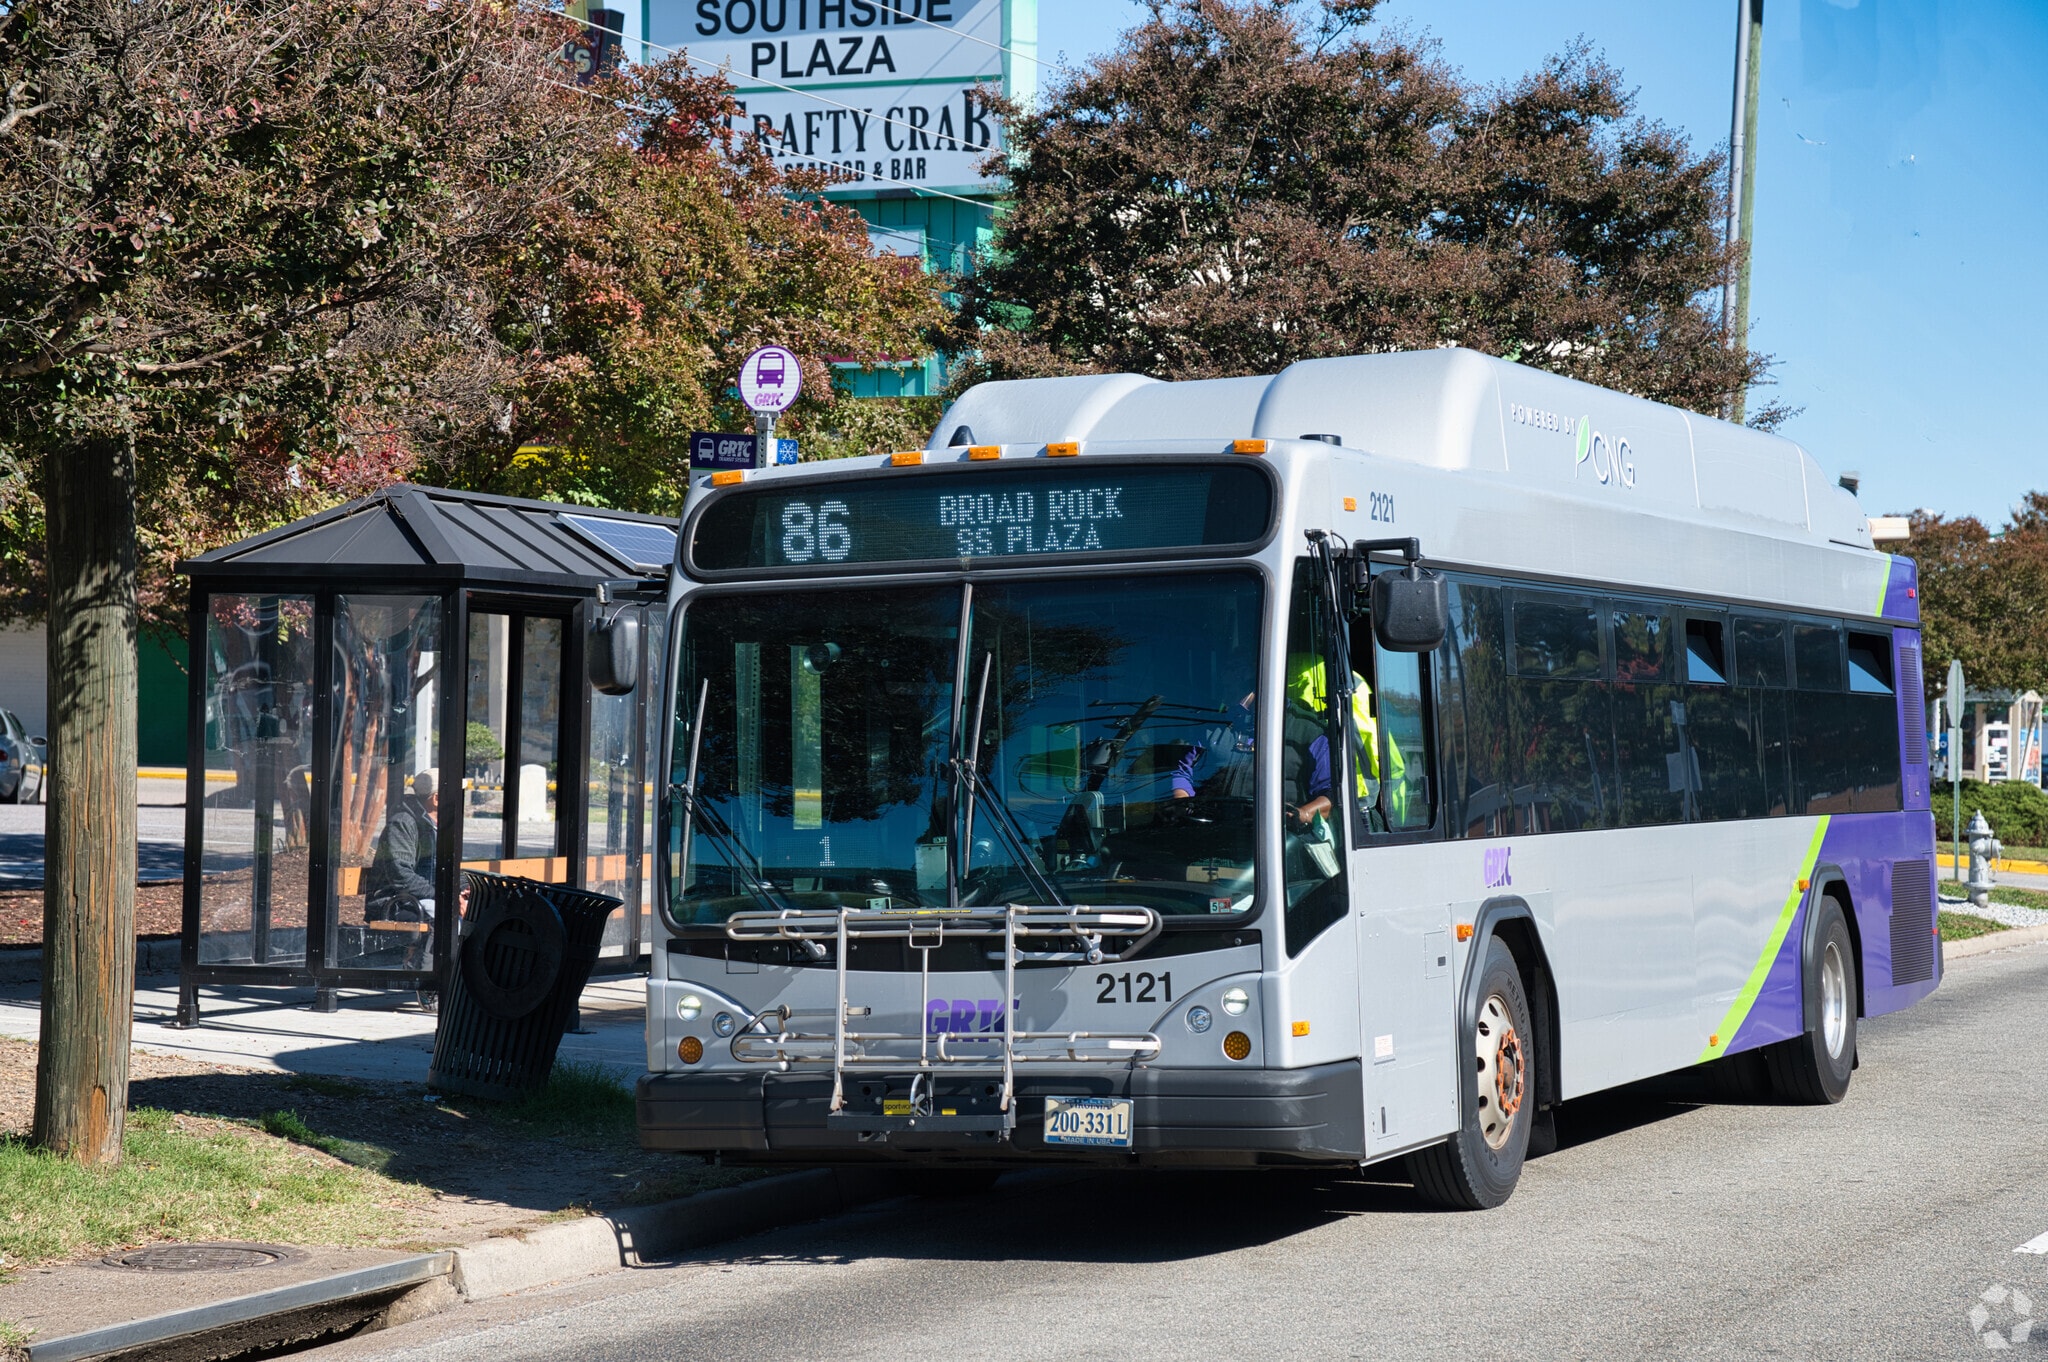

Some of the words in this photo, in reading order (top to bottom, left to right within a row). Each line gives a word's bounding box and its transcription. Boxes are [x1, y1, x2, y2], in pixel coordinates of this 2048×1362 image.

[695, 0, 953, 36] SOUTHSIDE
[751, 35, 897, 80] PLAZA
[884, 89, 991, 153] CRAB
[784, 160, 865, 182] SFOOD
[873, 161, 884, 178] &
[891, 157, 927, 180] BAR
[754, 392, 784, 407] GRTC
[1510, 402, 1560, 432] POWERED
[1564, 415, 1577, 437] BY
[718, 439, 753, 458] GRTC
[1591, 430, 1636, 490] CNG
[781, 500, 851, 562] 86
[940, 491, 1034, 526] BROAD
[1049, 487, 1123, 522] ROCK
[1369, 491, 1395, 524] 2121
[957, 527, 993, 555] SS
[1007, 524, 1103, 553] PLAZA
[1483, 846, 1512, 889] GRTC
[1211, 902, 1218, 912] 5
[1096, 971, 1172, 1004] 2121
[919, 998, 1020, 1043] GRTC
